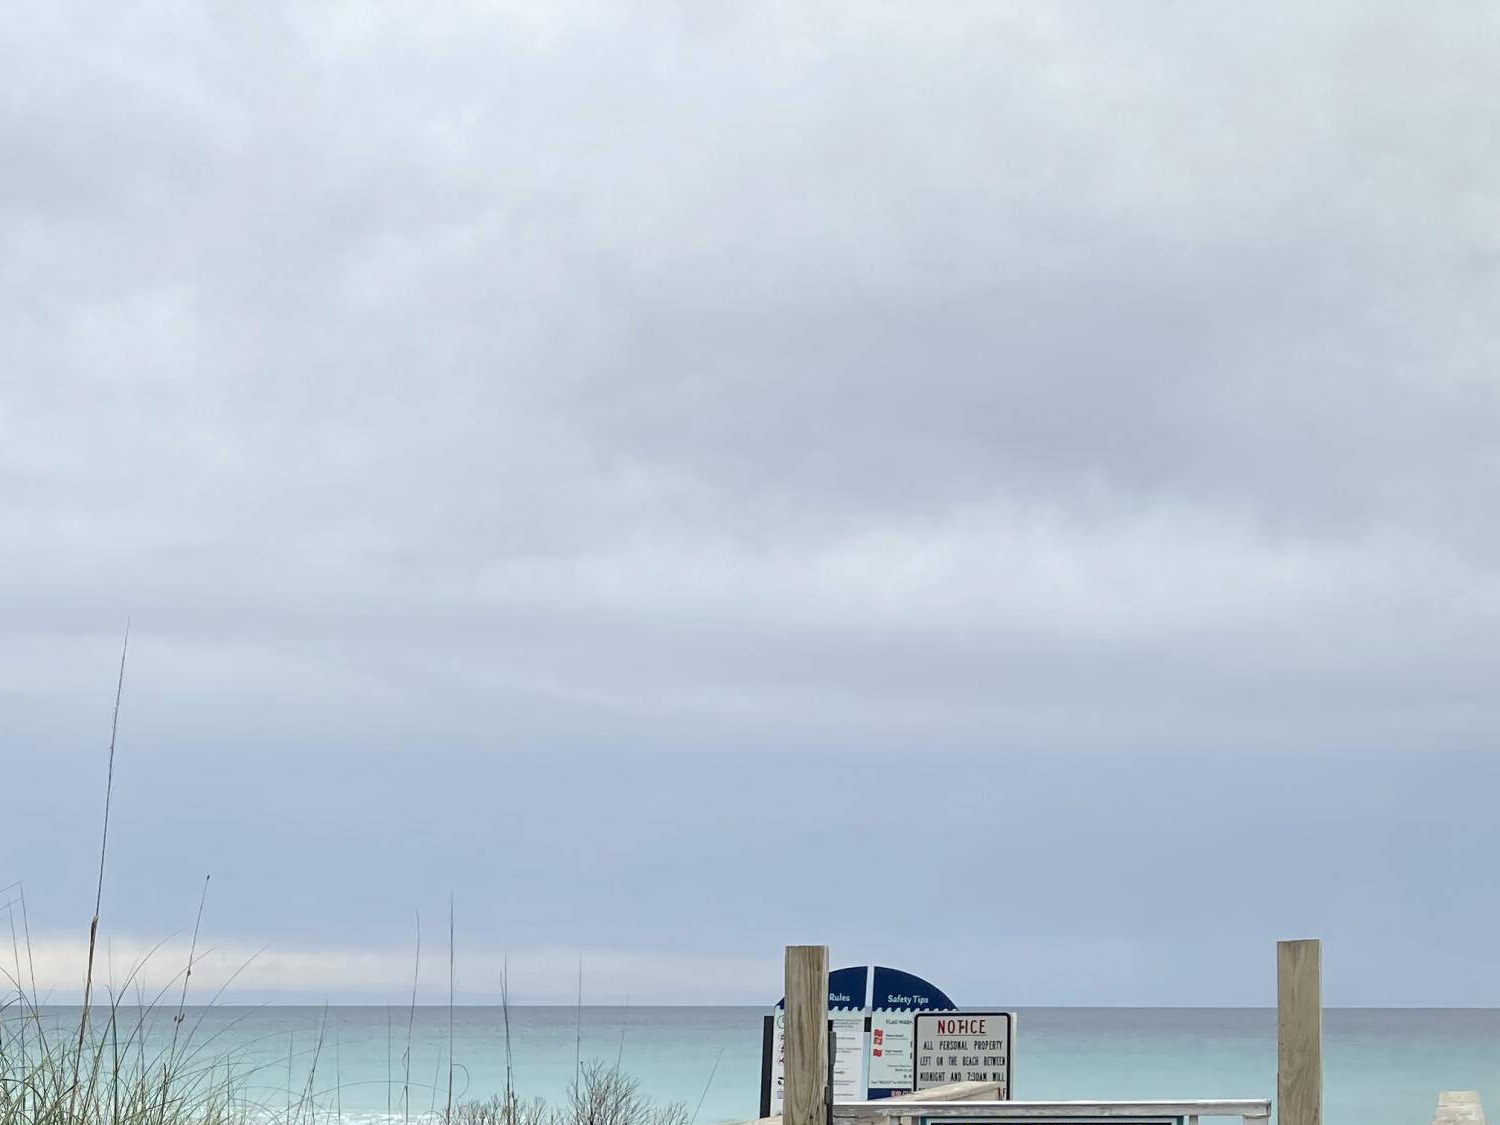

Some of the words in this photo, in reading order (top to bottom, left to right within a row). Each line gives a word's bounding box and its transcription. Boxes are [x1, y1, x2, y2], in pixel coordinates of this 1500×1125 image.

[829, 993, 851, 1002] Rules
[887, 994, 911, 1005] Safety
[912, 995, 929, 1005] Tips
[937, 1020, 986, 1034] NOTICE
[923, 1041, 934, 1051] ALL
[939, 1041, 968, 1051] PERSONAL
[974, 1040, 1003, 1051] PROPERTY
[920, 1056, 932, 1066] LEFT
[936, 1056, 944, 1066] ON
[948, 1056, 958, 1066] THE
[962, 1056, 979, 1066] BEACH
[983, 1056, 1006, 1066] BETWEEN
[920, 1071, 946, 1082] MIDNIGHT
[950, 1072, 962, 1082] AND
[967, 1072, 988, 1082] 7:30AM
[992, 1072, 1005, 1082] WILL
